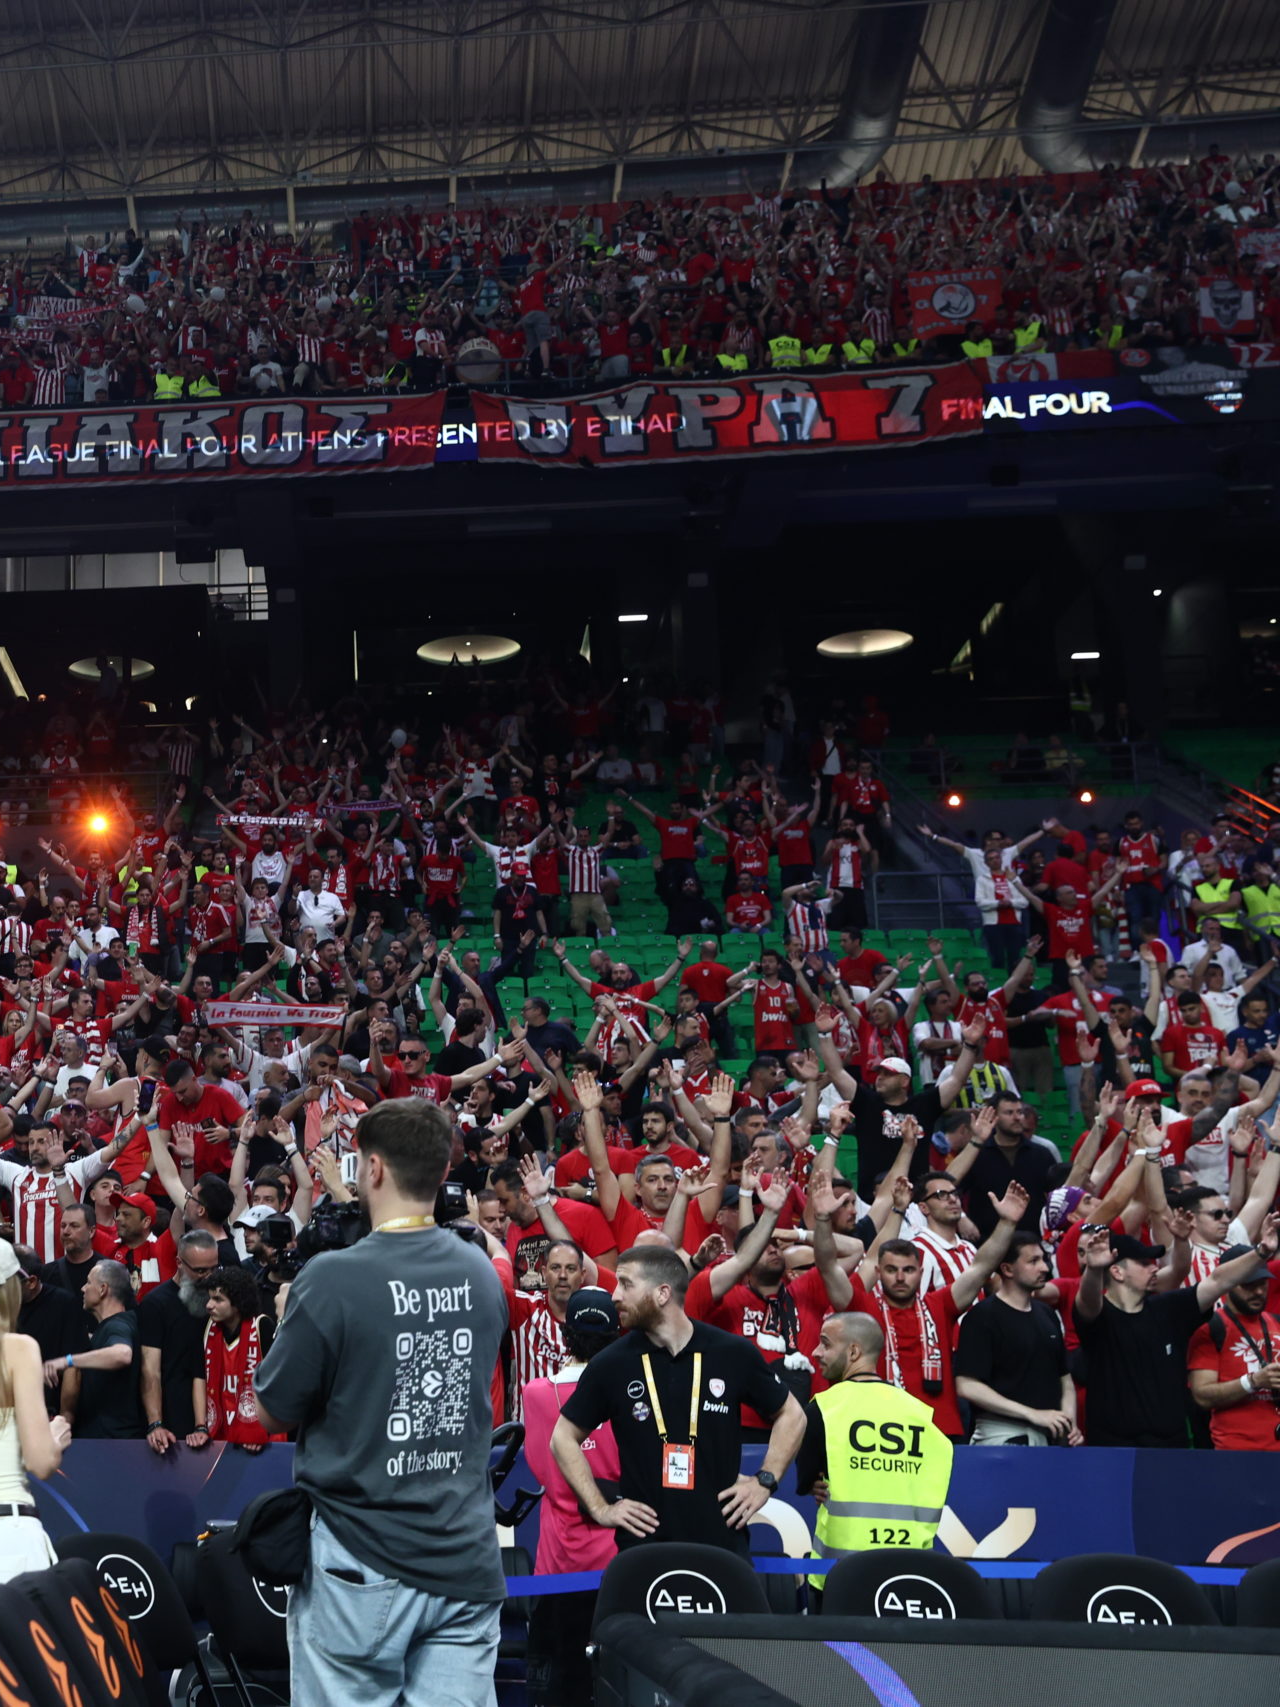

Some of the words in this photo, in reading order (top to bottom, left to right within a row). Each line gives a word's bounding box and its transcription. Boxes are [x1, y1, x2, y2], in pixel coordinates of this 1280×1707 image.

[862, 373, 935, 441] 7
[941, 396, 1026, 420] FINAL
[1029, 391, 1112, 417] FOUR
[105, 438, 178, 460] FINAL
[187, 432, 257, 456] FOUR
[264, 428, 370, 453] ATHENS
[541, 418, 577, 440] BY
[586, 414, 688, 437] ETIHAD
[762, 1011, 787, 1022] bwin
[769, 996, 781, 1008] 10
[387, 1280, 422, 1316] Be
[426, 1278, 473, 1323] part
[703, 1400, 729, 1414] bwin
[848, 1419, 925, 1458] CSI
[386, 1450, 405, 1477] of
[406, 1449, 425, 1475] the
[426, 1447, 462, 1475] story.
[849, 1456, 923, 1475] SECURITY
[869, 1527, 911, 1545] 122
